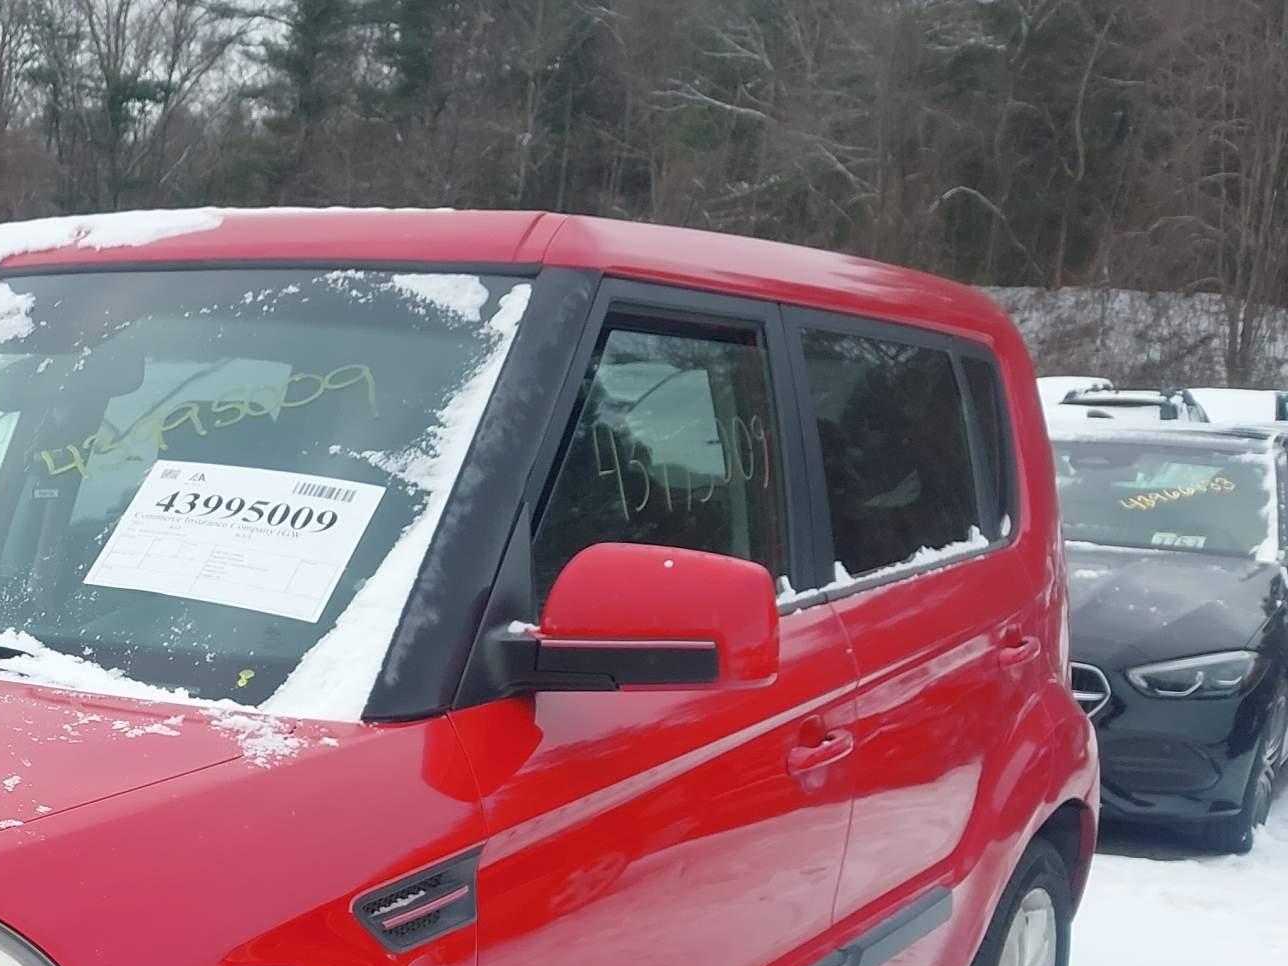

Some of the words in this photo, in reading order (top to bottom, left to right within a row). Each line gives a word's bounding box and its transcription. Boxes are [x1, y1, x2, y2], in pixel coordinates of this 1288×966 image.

[134, 511, 183, 524] Commerce
[184, 516, 229, 529] Insurance
[230, 522, 274, 537] Company
[155, 490, 339, 534] 43995009
